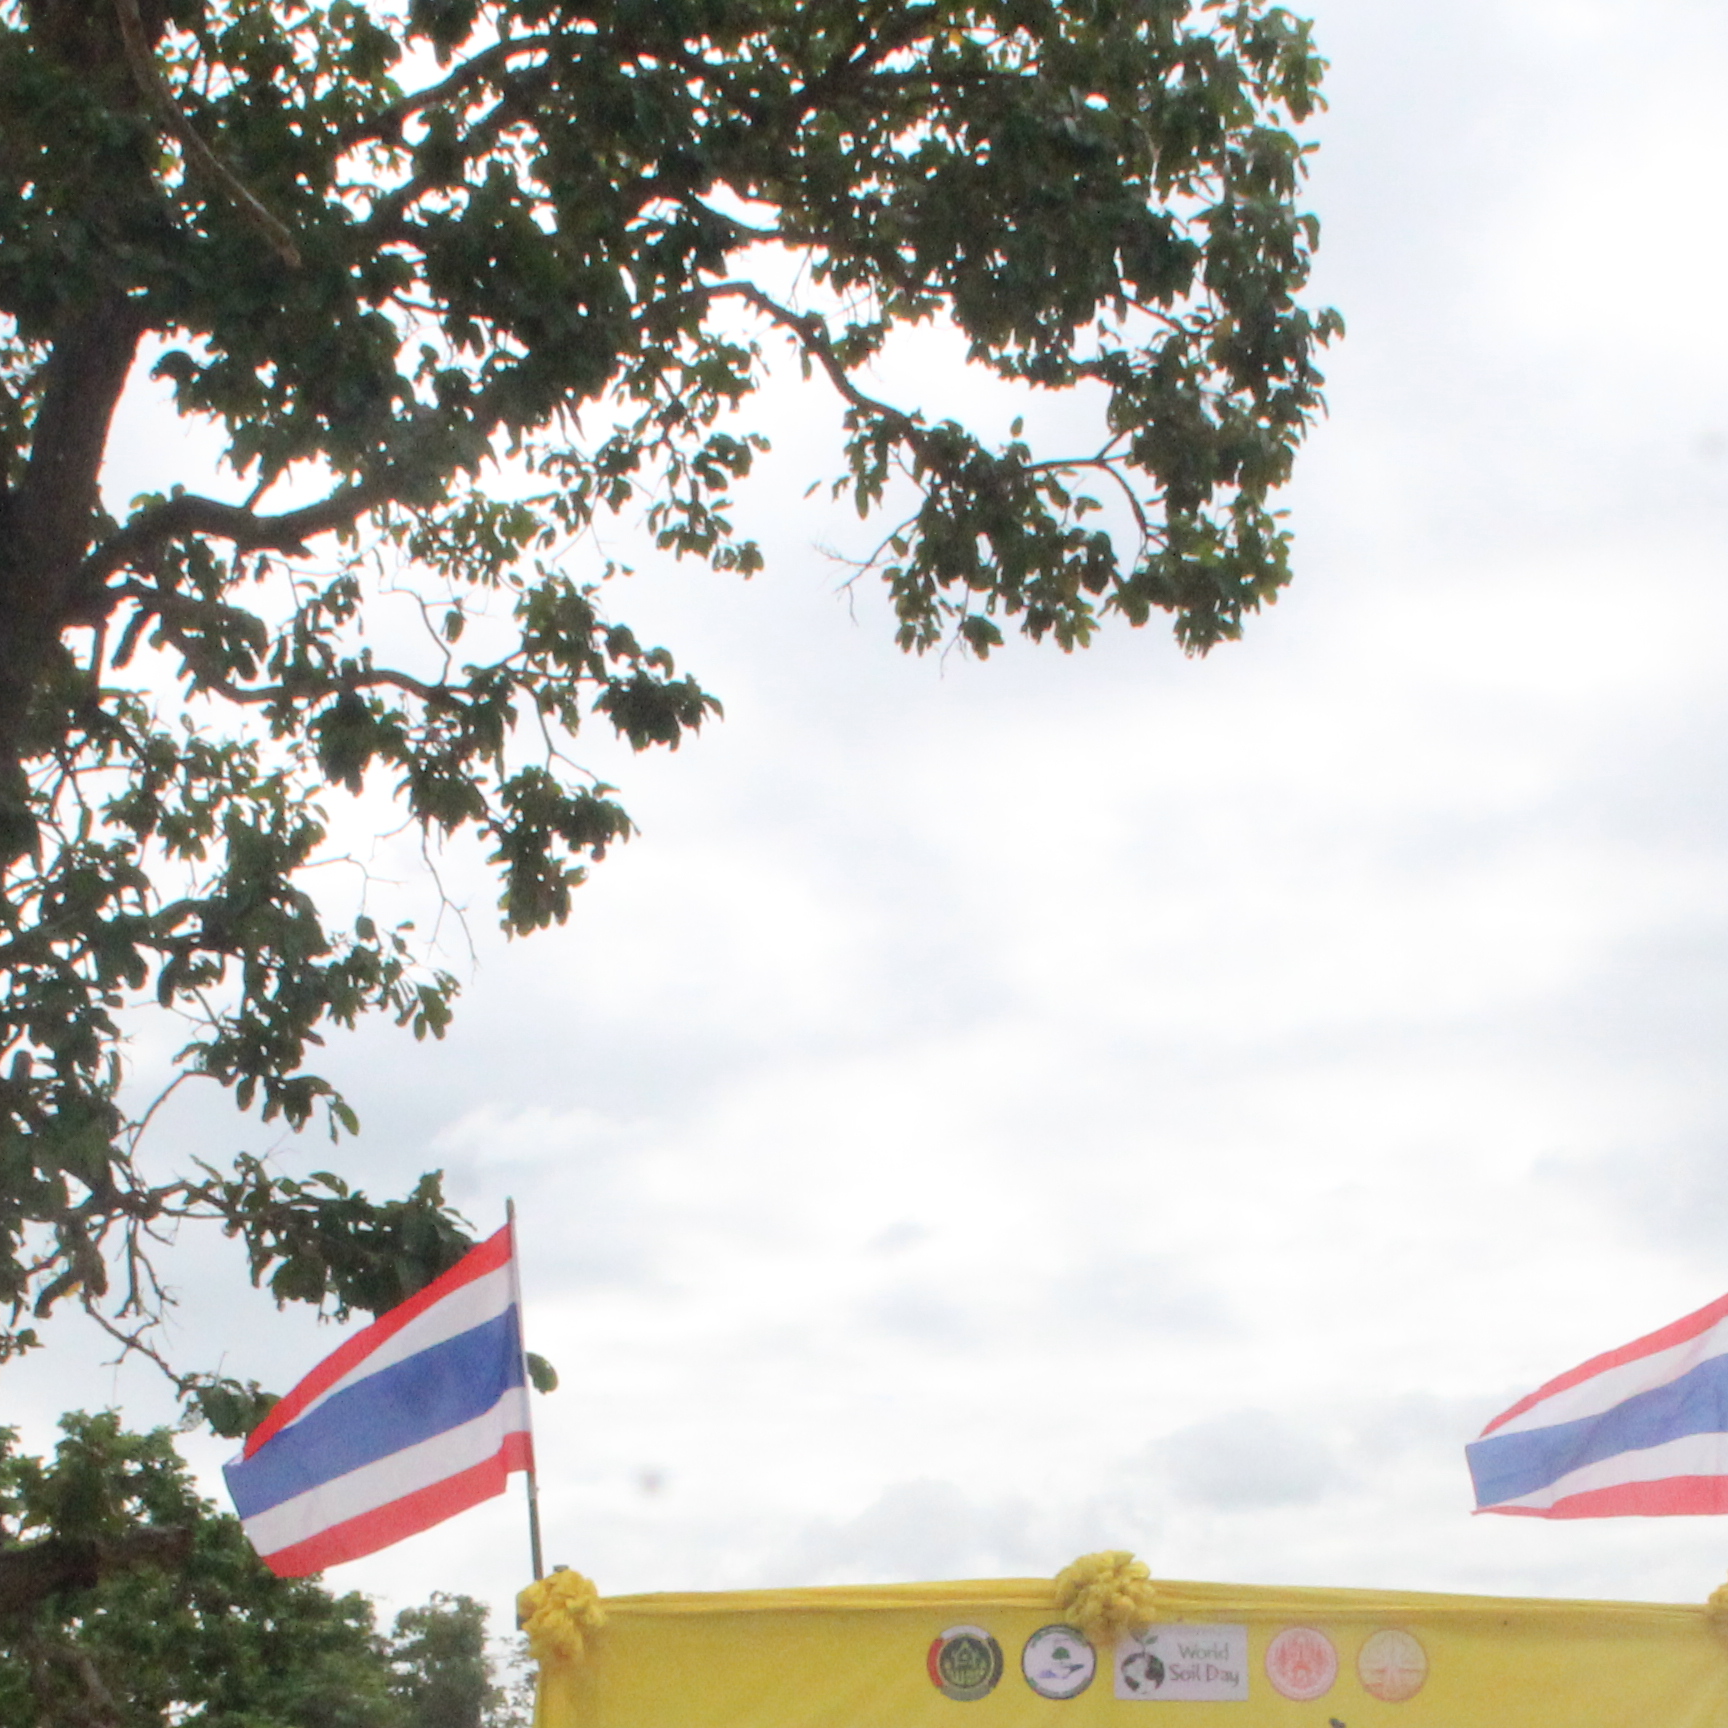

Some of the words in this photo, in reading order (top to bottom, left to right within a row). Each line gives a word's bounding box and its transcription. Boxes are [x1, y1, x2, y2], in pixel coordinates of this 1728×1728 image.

[1176, 1641, 1230, 1661] World
[1168, 1662, 1201, 1682] Soil
[1205, 1662, 1241, 1688] Day
